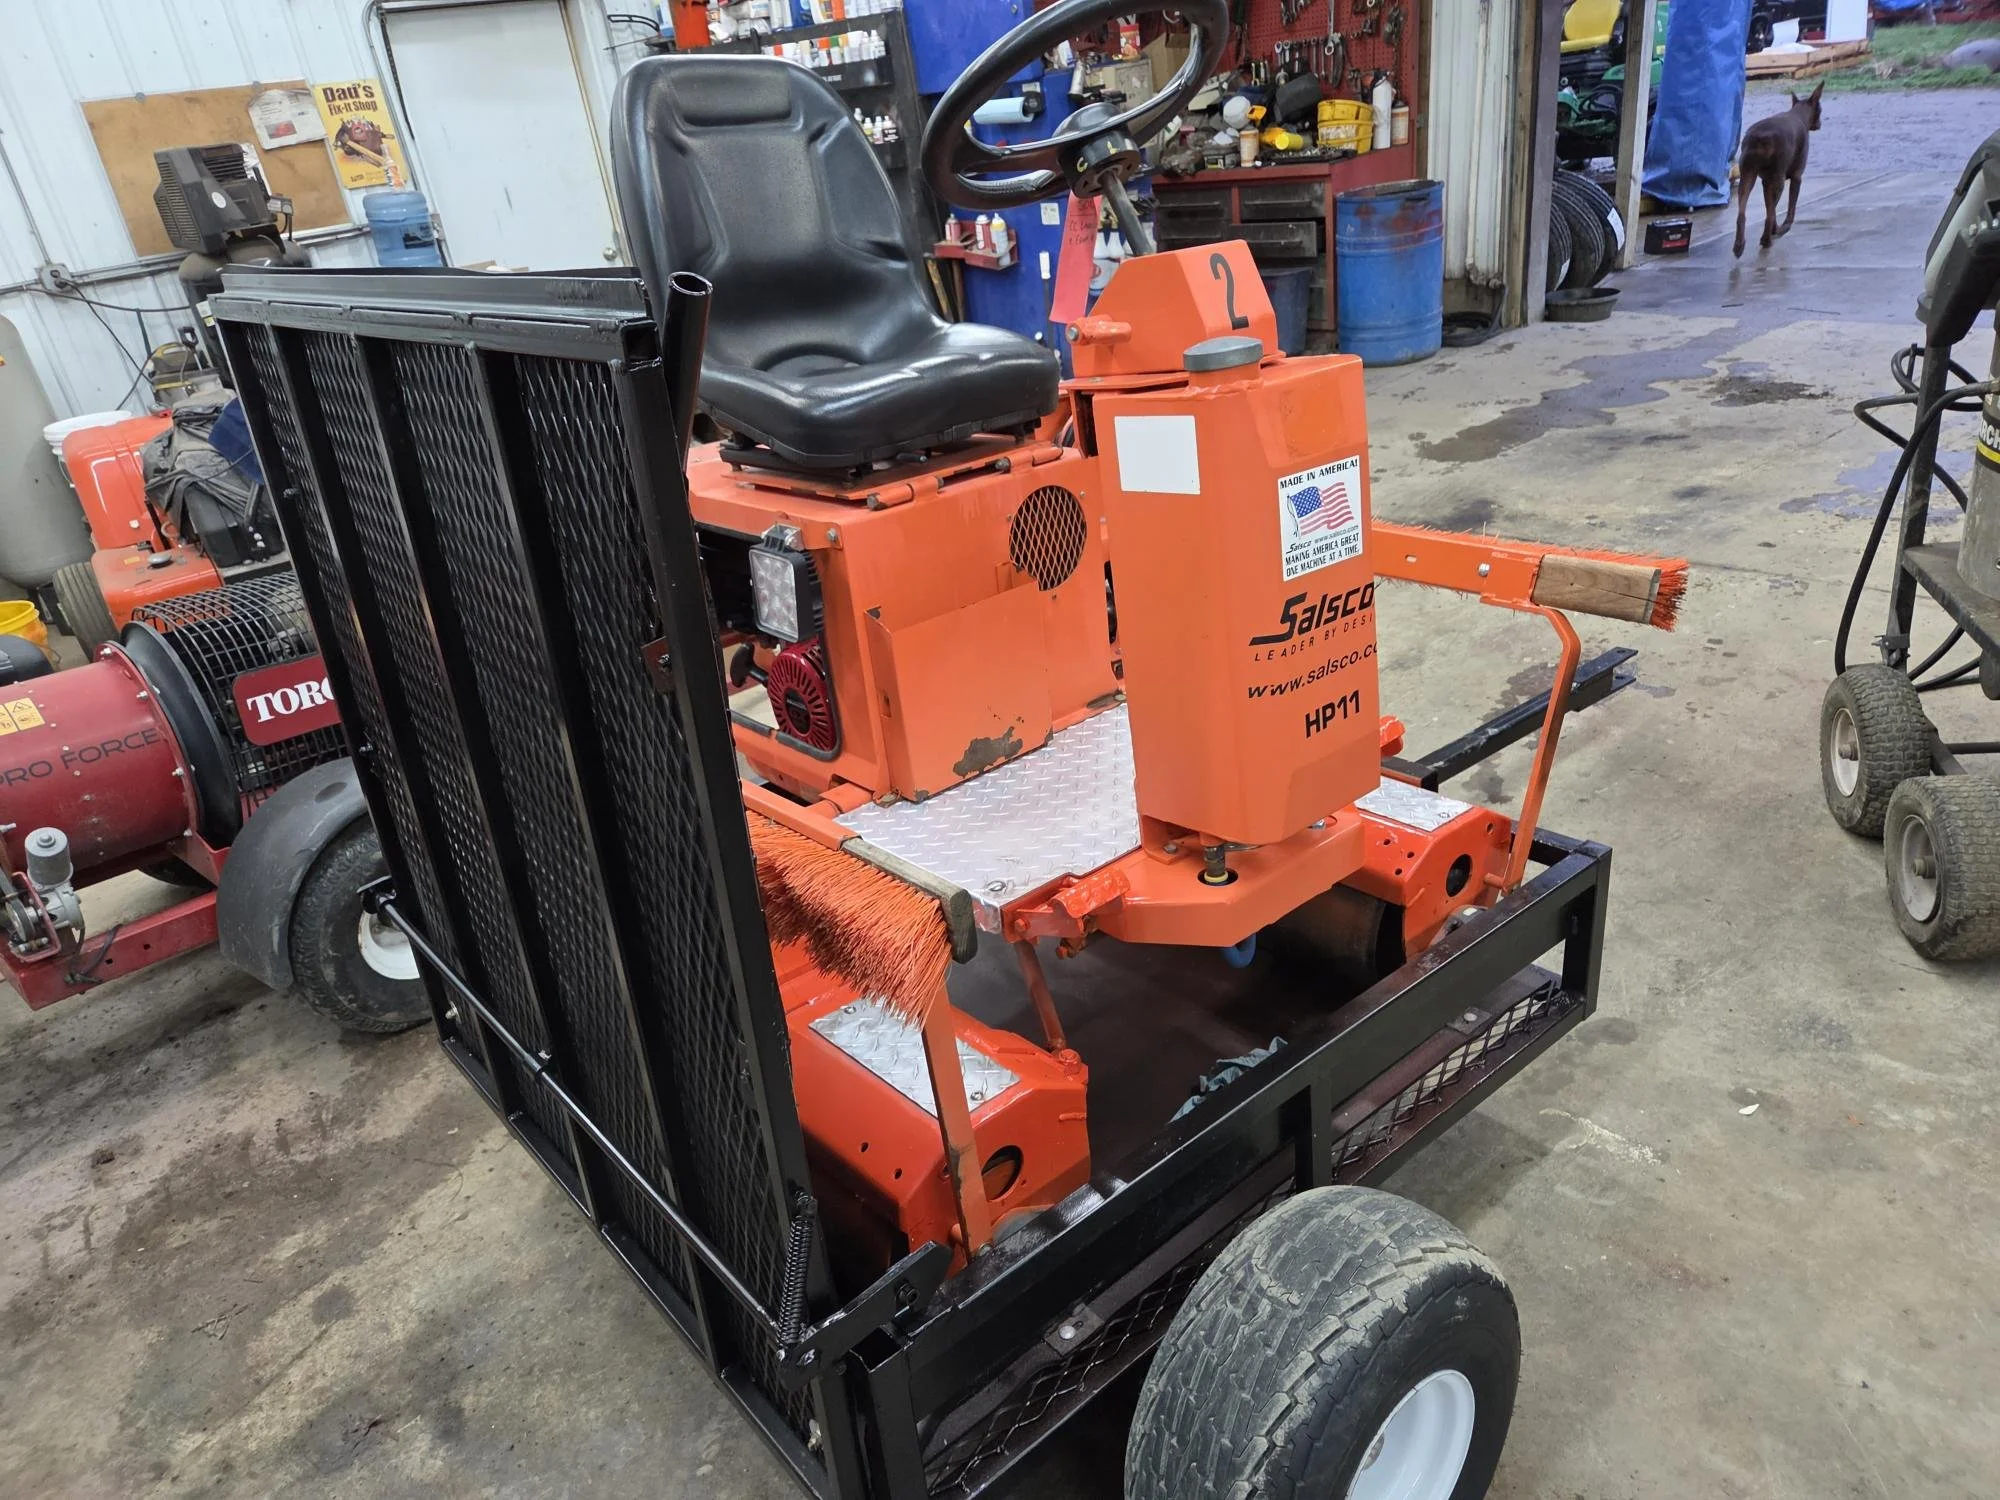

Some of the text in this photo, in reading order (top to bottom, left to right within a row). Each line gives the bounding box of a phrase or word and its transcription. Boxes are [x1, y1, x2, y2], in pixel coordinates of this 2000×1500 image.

[322, 83, 375, 103] Dad's
[352, 100, 378, 112] Shop
[1209, 253, 1250, 330] 2
[1280, 459, 1358, 489] MADE IN AMERICA!
[1285, 533, 1360, 566] MAKING AMERICA GREAT
[1286, 525, 1359, 554] Salsco www.salsco.com
[1286, 565, 1302, 577] ONE
[1300, 556, 1327, 574] MACHINE
[1328, 553, 1336, 563] AT
[1338, 550, 1343, 558] A
[1249, 581, 1375, 646] Salsco
[1254, 637, 1315, 662] LEADER
[1324, 627, 1337, 641] BY
[1305, 689, 1360, 738] HP11
[0, 728, 161, 786] RO FORCE
